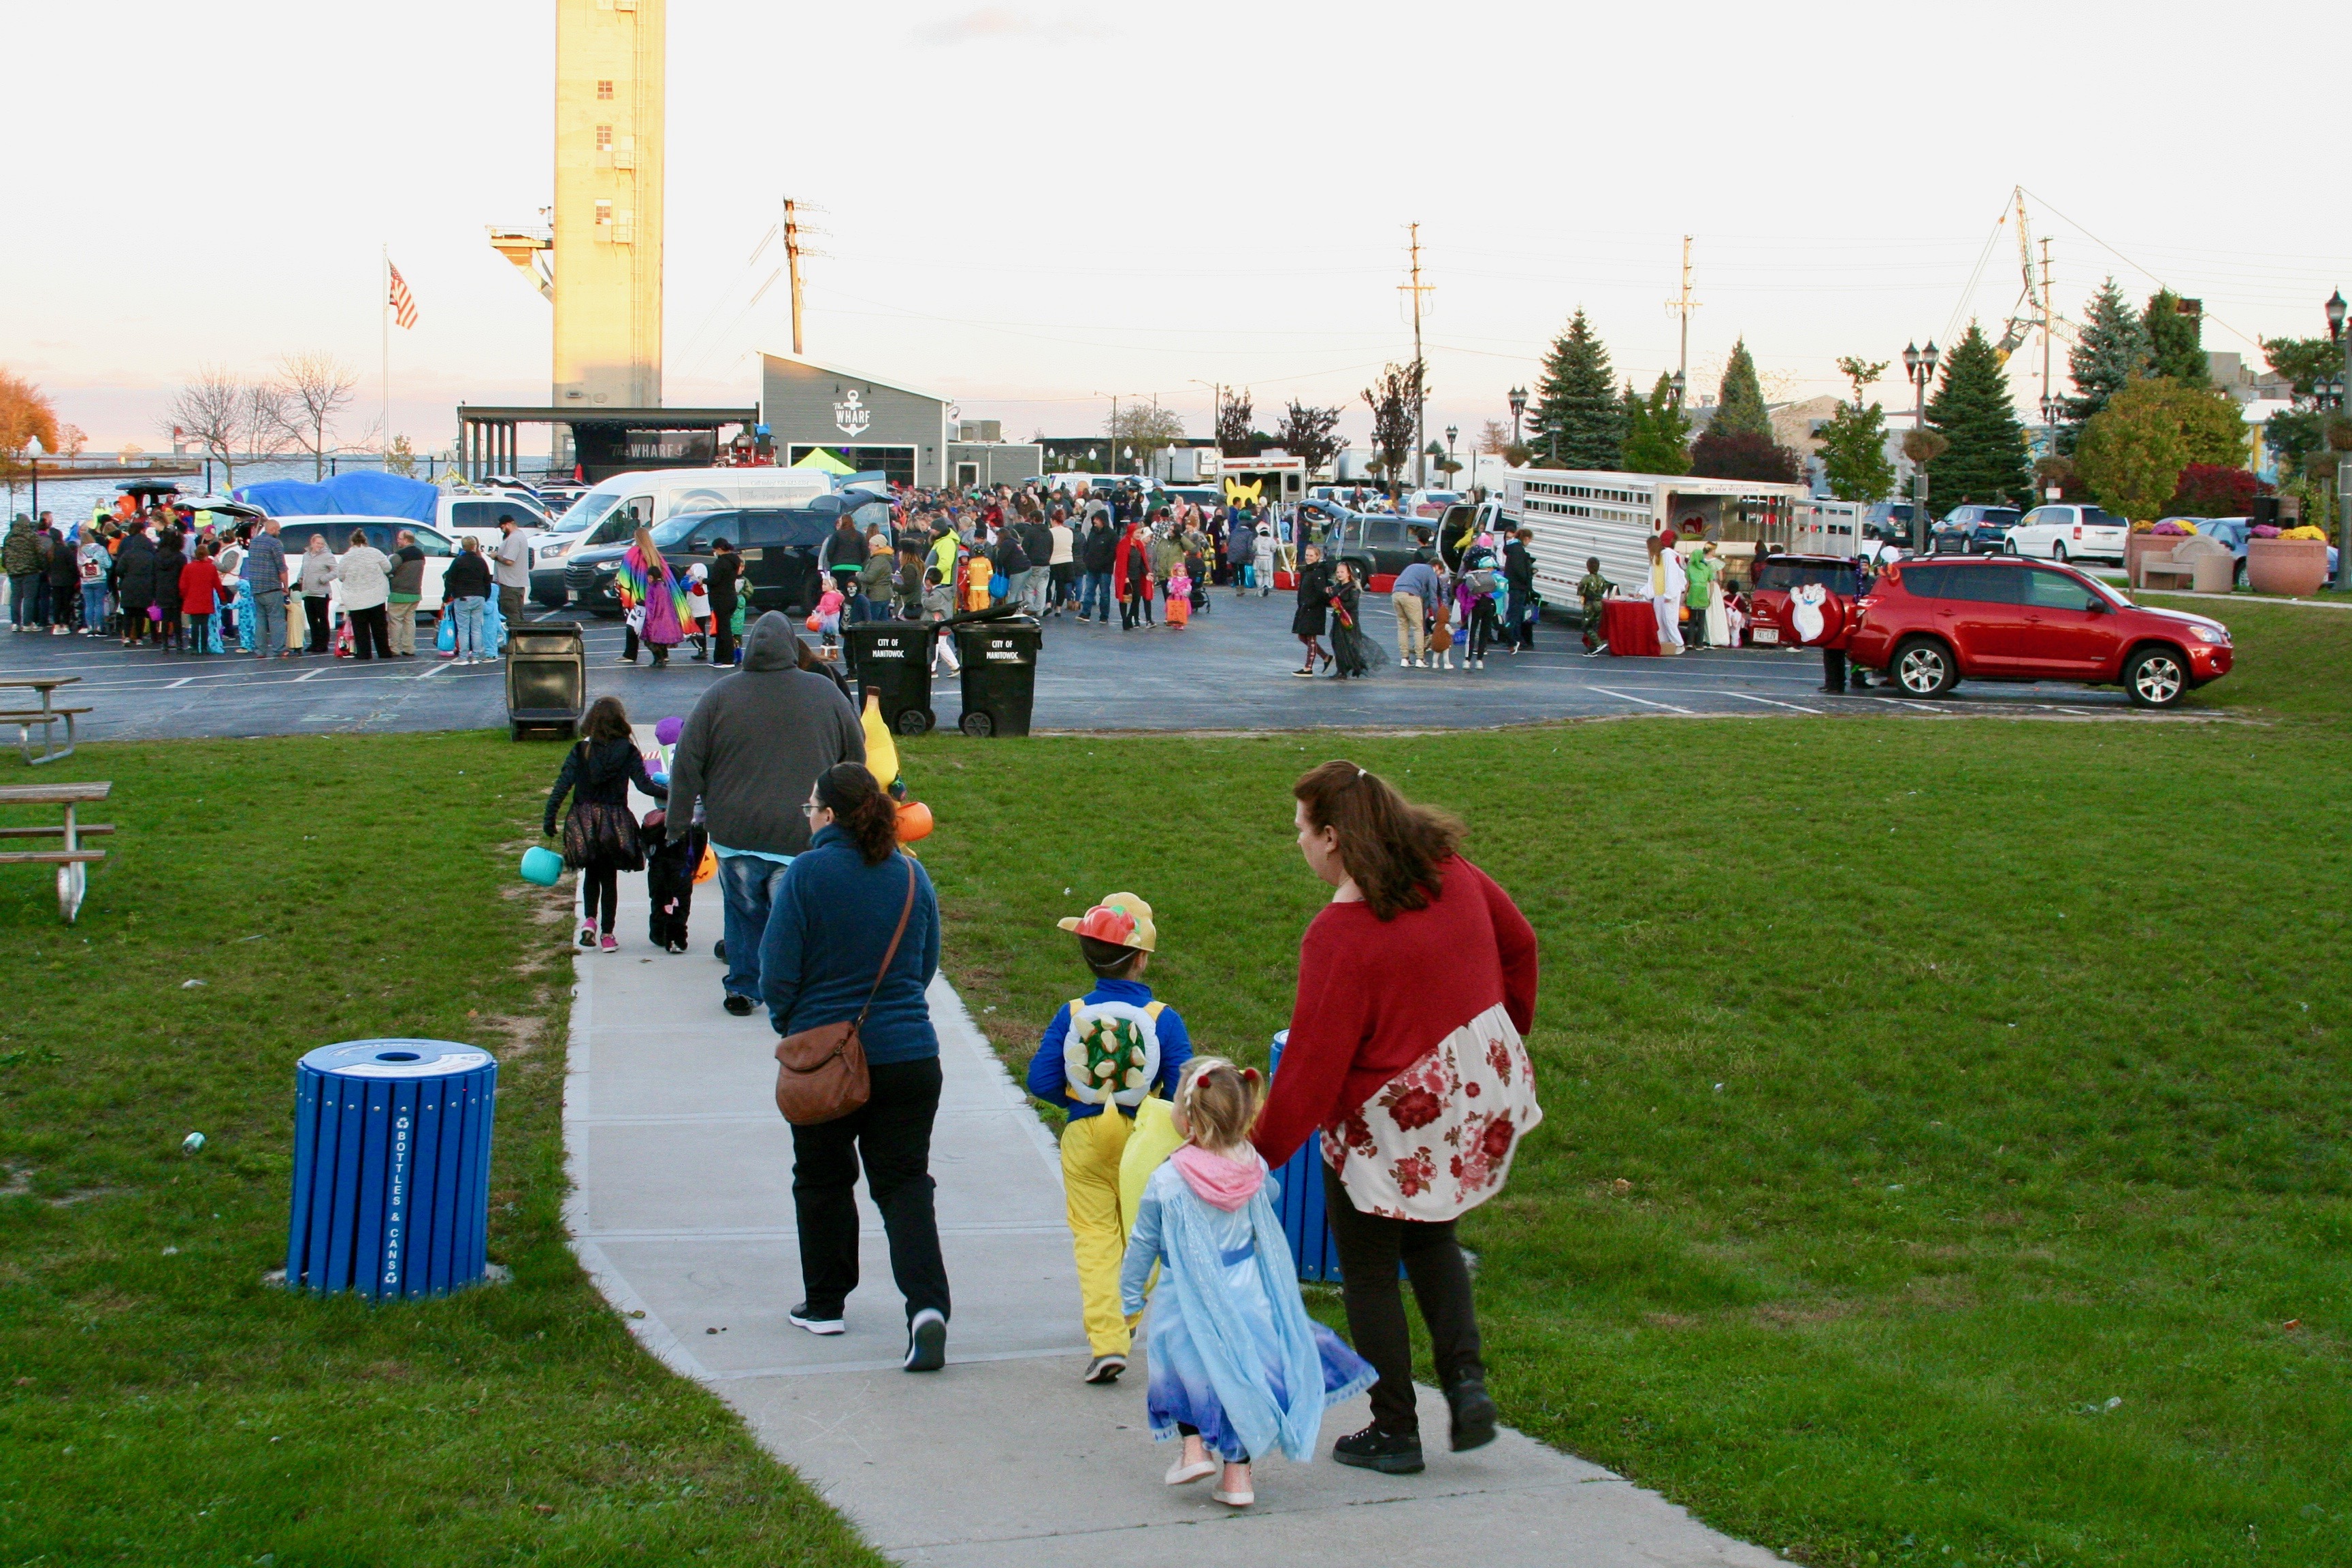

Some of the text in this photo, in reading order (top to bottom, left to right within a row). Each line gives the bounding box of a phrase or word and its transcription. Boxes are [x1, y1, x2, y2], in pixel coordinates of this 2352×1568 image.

[836, 410, 870, 423] WHARF
[608, 444, 674, 457] The WHARF
[877, 638, 899, 647] CITY OF
[992, 640, 1013, 649] CITY OF
[872, 649, 904, 658] MANITOWOC
[986, 651, 1019, 659] MANITOWOC
[388, 1131, 406, 1270] BOTTLES & CANS
